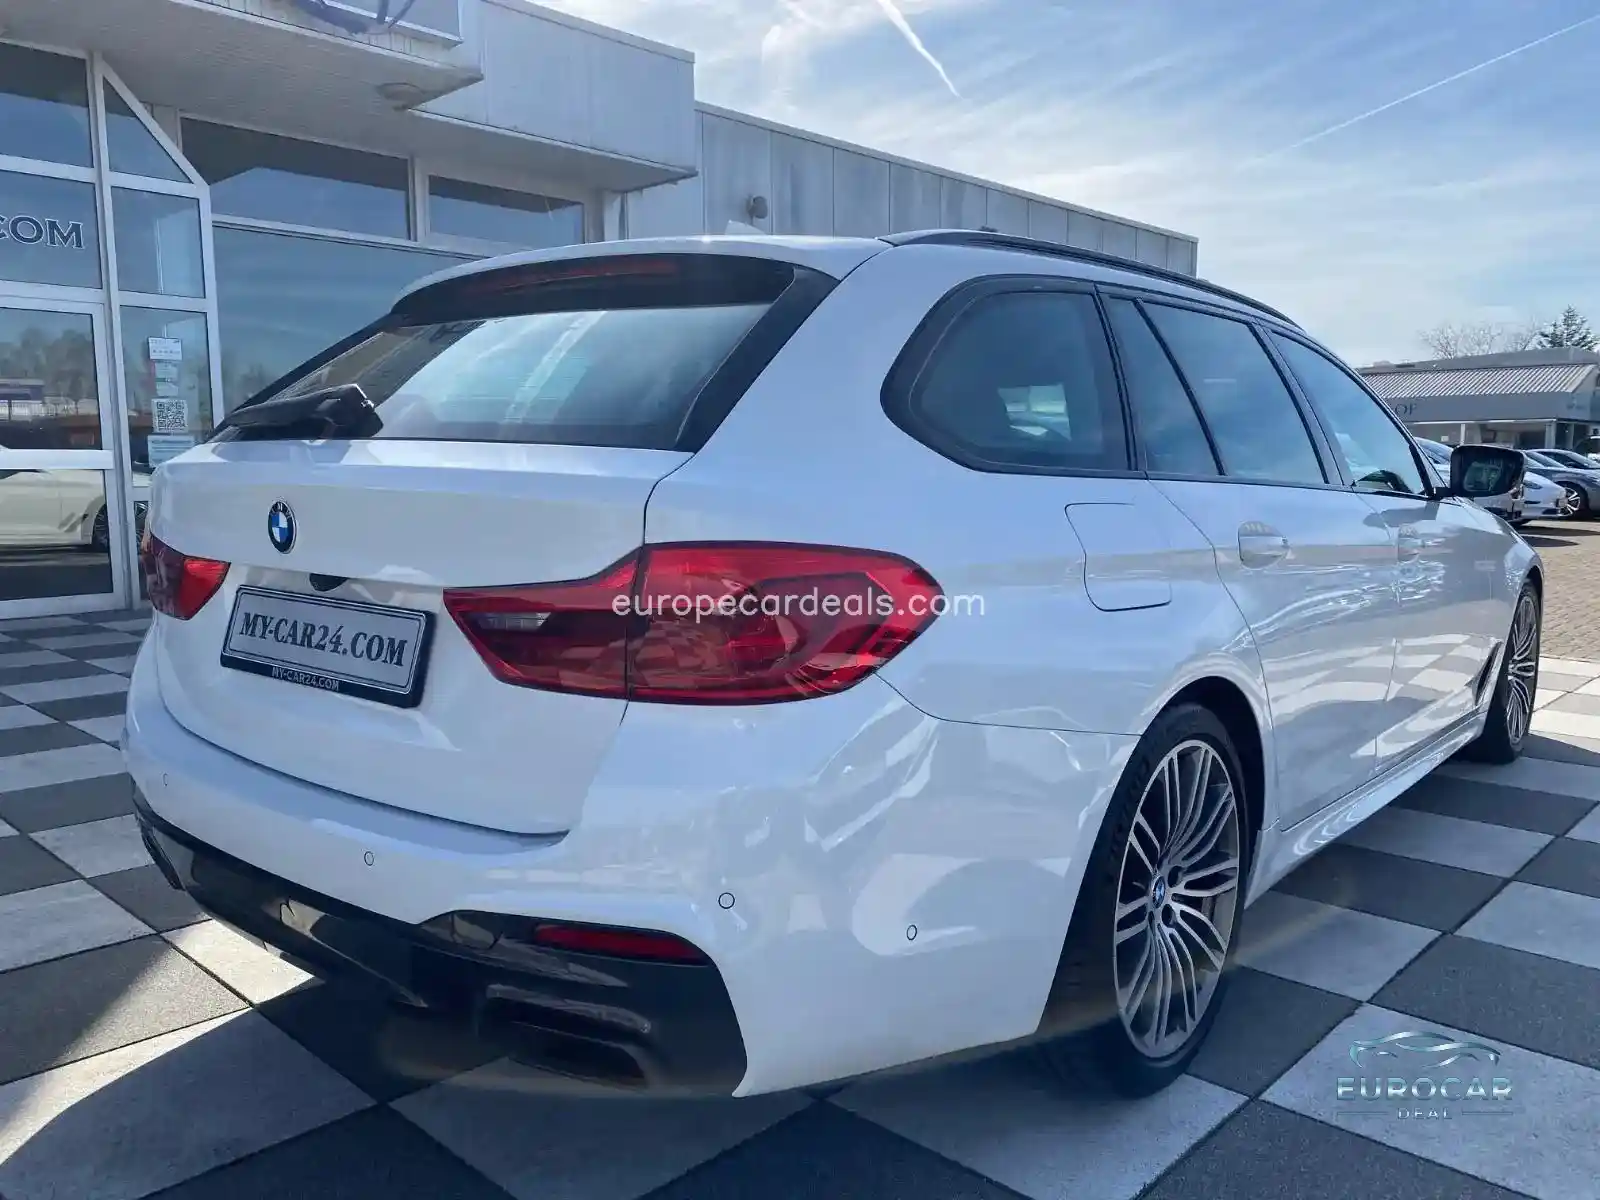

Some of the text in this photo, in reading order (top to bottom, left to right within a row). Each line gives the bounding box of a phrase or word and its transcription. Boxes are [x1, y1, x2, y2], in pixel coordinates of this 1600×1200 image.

[0, 214, 85, 249] OM
[240, 612, 408, 667] MY-CAR24.COM
[272, 667, 340, 691] MY-CAR24.COM
